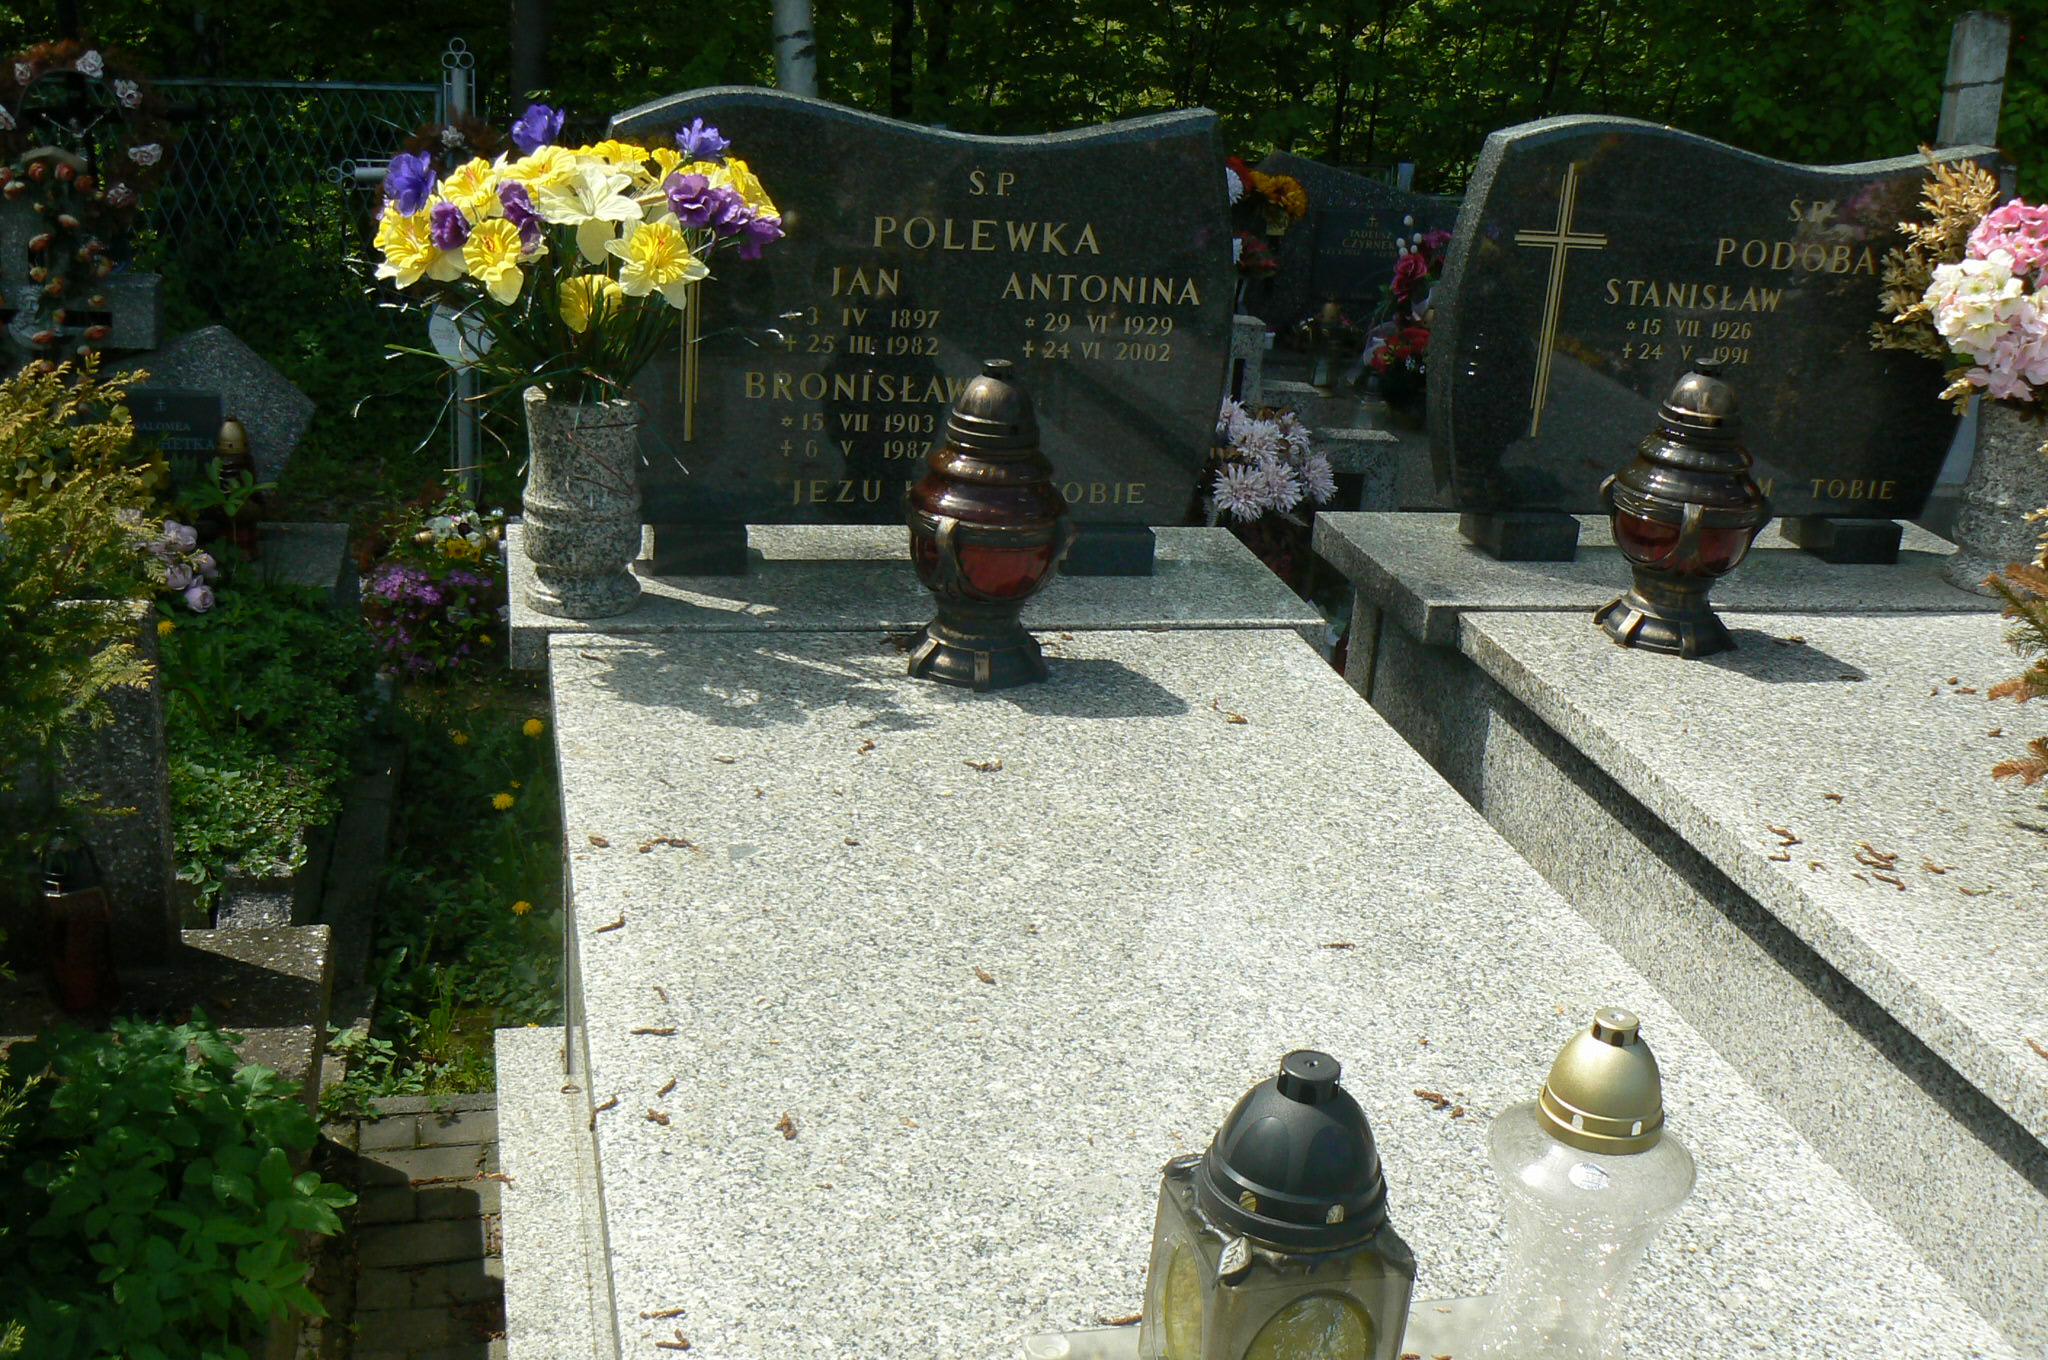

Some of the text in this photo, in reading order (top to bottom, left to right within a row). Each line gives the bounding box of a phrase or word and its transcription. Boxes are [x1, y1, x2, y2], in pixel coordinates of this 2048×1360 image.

[873, 215, 1101, 256] POLEWKA
[1714, 238, 1877, 275] PODOBA
[831, 266, 901, 297] JAN
[1001, 271, 1201, 306] ANTONINA
[1604, 278, 1783, 313] STANISŁAW
[806, 306, 942, 329] 3 IV 1897
[1044, 312, 1174, 336] 29 VI 1929
[1642, 318, 1752, 340] 15 VII 1926
[806, 334, 940, 356] 25 III 1982
[1043, 340, 1171, 362] 24 VI 2002
[1639, 343, 1749, 364] 24 V 1991
[744, 371, 974, 404] BRONISŁAW
[801, 412, 936, 433] 15 VII 1903
[805, 439, 934, 459] 6 V 1987
[793, 479, 882, 504] JEZU
[1050, 481, 1146, 504] OBIE
[1810, 479, 1897, 500] TOBIE
